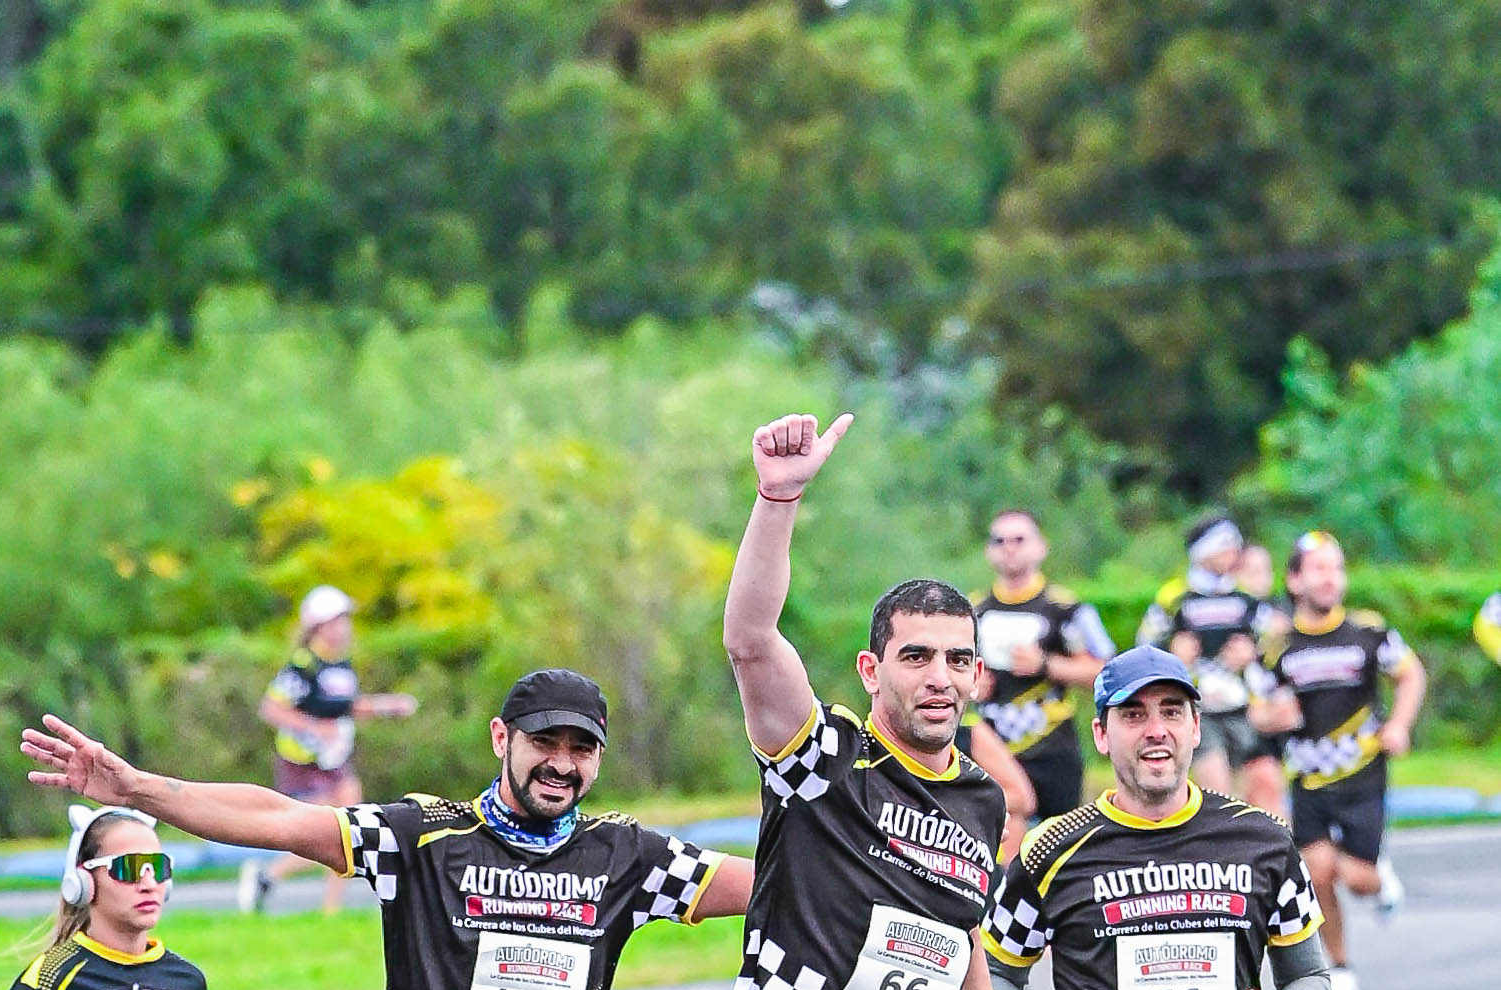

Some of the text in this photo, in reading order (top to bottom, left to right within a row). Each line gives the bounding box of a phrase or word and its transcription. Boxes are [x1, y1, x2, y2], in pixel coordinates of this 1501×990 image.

[877, 801, 995, 873] AUTÓDROMO
[868, 844, 881, 857] La
[881, 850, 913, 872] Carrera
[913, 868, 926, 879] de
[926, 870, 939, 884] los
[954, 859, 983, 889] RACE
[459, 864, 609, 902] AUTÓDROMO
[1093, 860, 1252, 903] AUTÓDROMO
[482, 899, 584, 922] RUNNING RACE
[1119, 893, 1233, 919] RUNNING RACE
[452, 916, 463, 928] La
[464, 917, 498, 930] Carrera
[499, 920, 512, 931] de
[512, 921, 526, 933] los
[527, 923, 556, 935] Clubes
[557, 924, 572, 936] del
[885, 921, 959, 958] AUTÓDROMO
[1093, 928, 1105, 938] La
[1105, 925, 1140, 937] Carrera
[1141, 922, 1154, 933] de
[1154, 920, 1169, 931] los
[1170, 918, 1202, 930] Clubes
[1203, 917, 1218, 927] del
[494, 943, 575, 971] AUTÓDROMO
[1135, 941, 1217, 965] AUTÓDROMO
